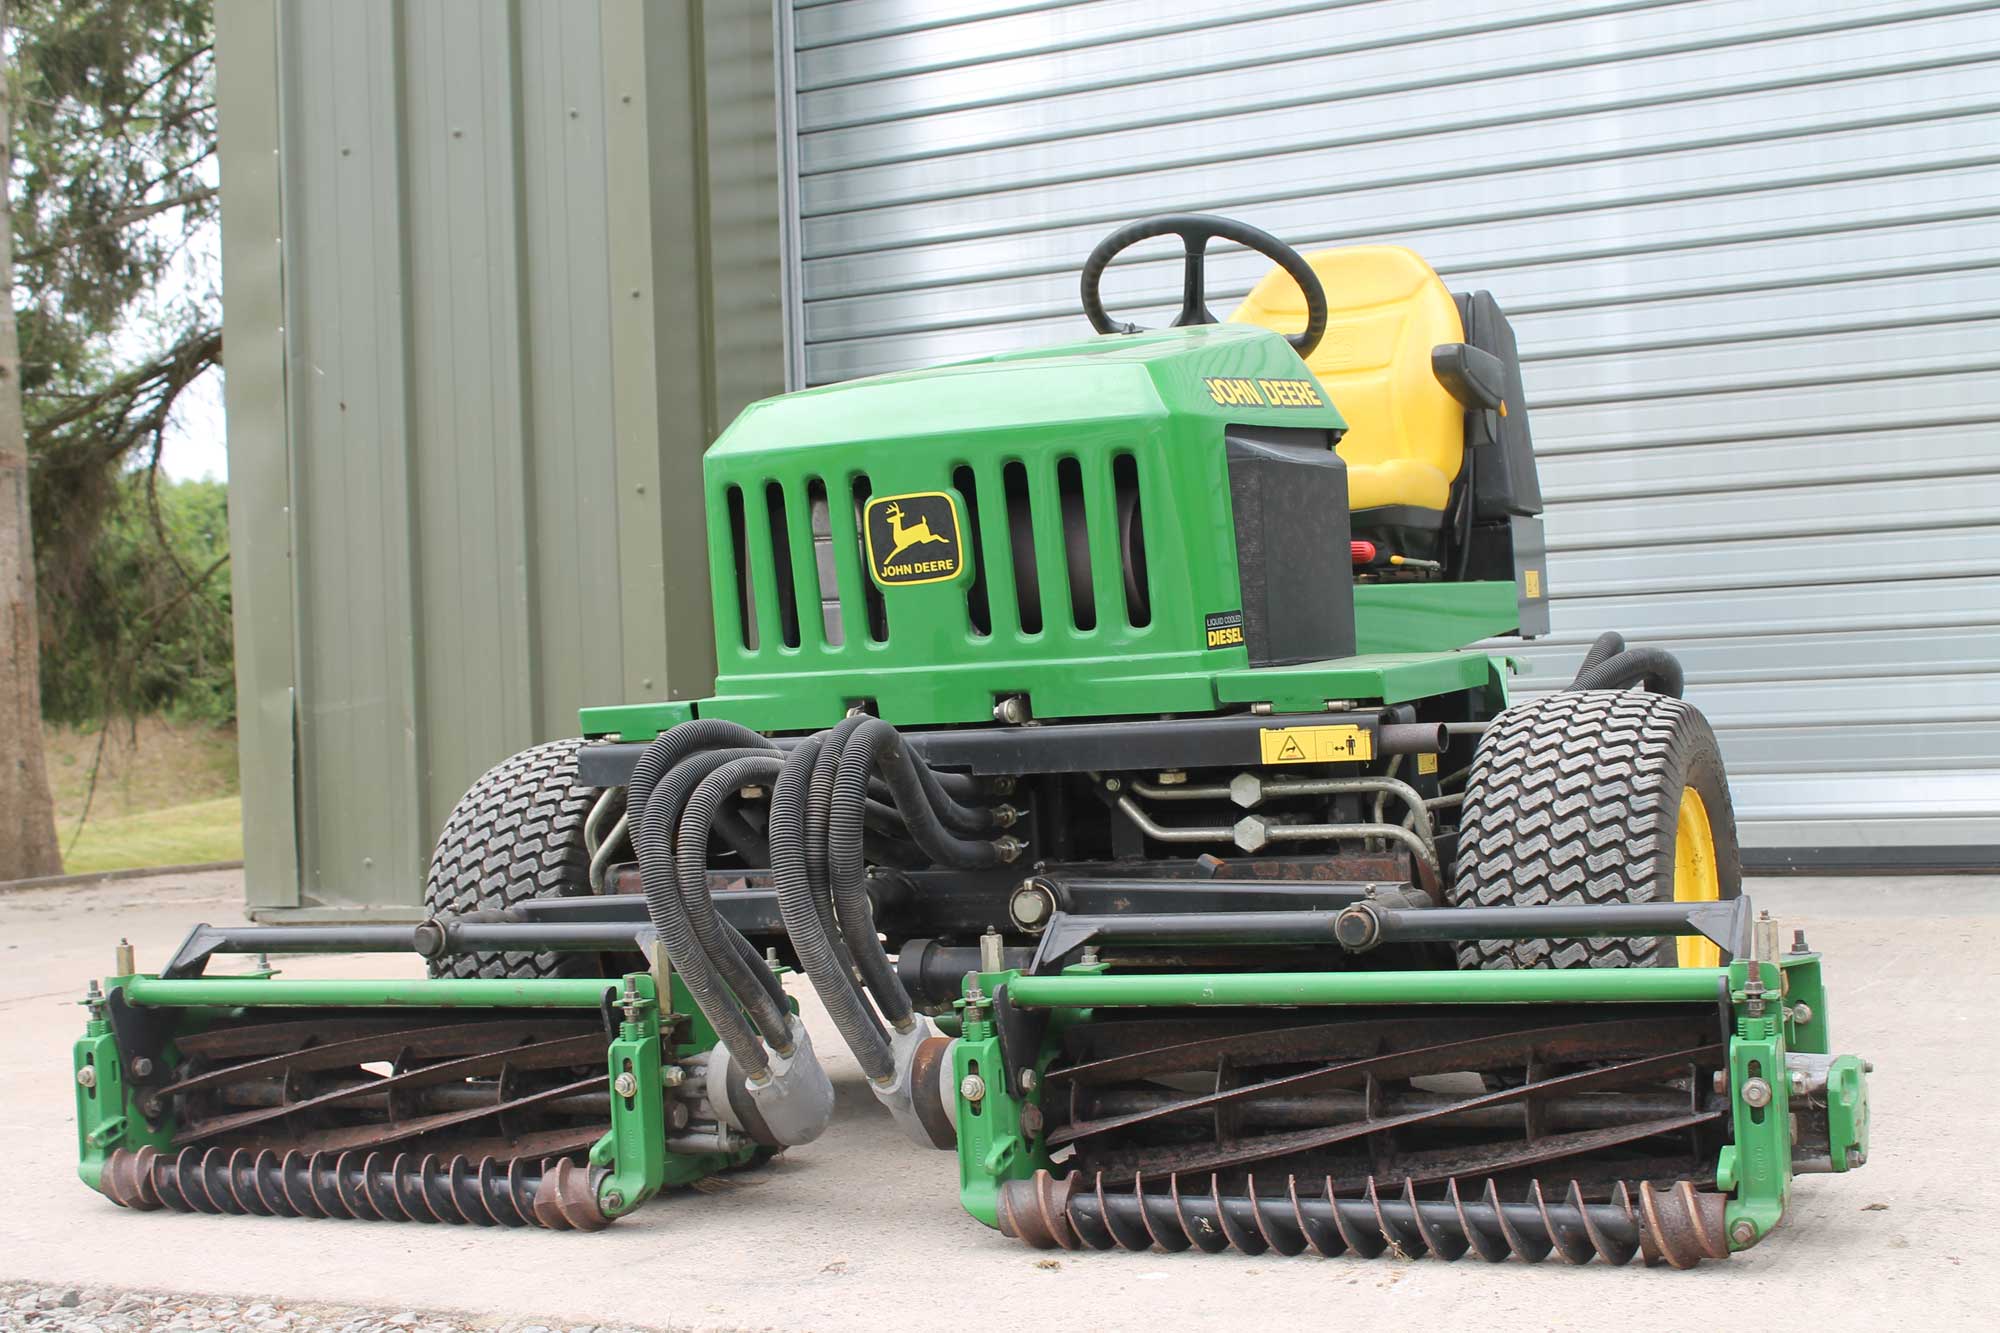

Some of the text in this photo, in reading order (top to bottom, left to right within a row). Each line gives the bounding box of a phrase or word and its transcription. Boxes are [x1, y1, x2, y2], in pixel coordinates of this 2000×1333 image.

[1202, 377, 1325, 408] JOHN DEERE
[881, 560, 954, 577] JOHN DEERE
[1208, 627, 1243, 646] DIESEL
